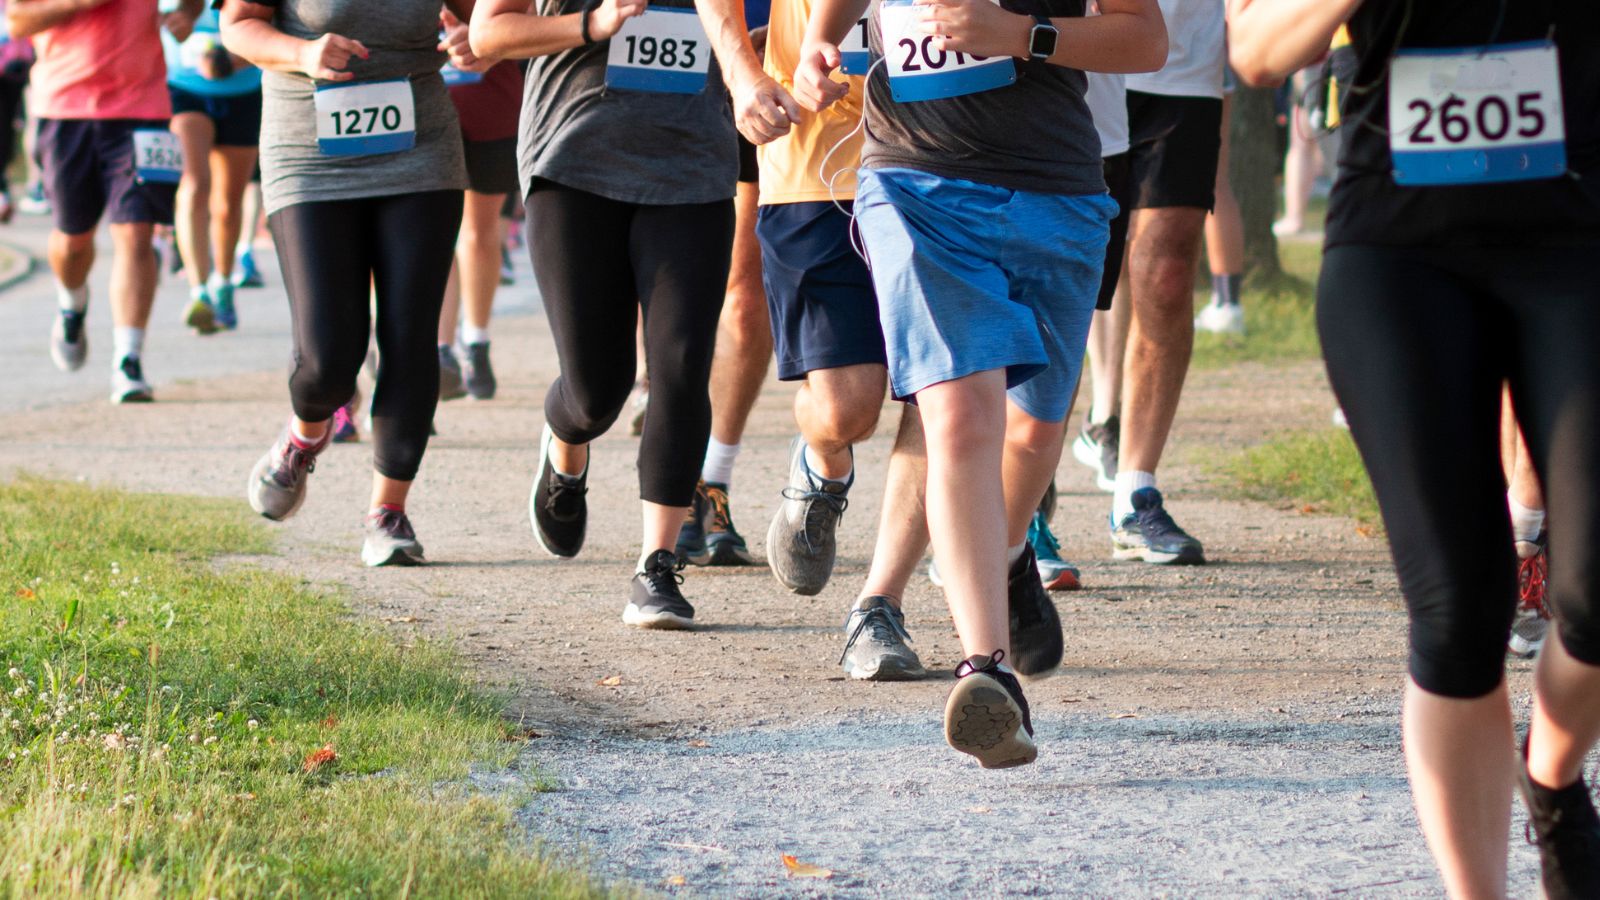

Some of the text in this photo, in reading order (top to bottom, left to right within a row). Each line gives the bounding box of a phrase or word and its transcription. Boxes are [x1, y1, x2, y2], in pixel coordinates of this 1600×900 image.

[625, 35, 697, 68] 1983
[898, 35, 990, 71] 201
[331, 105, 401, 135] 1270
[1408, 91, 1545, 143] 2605
